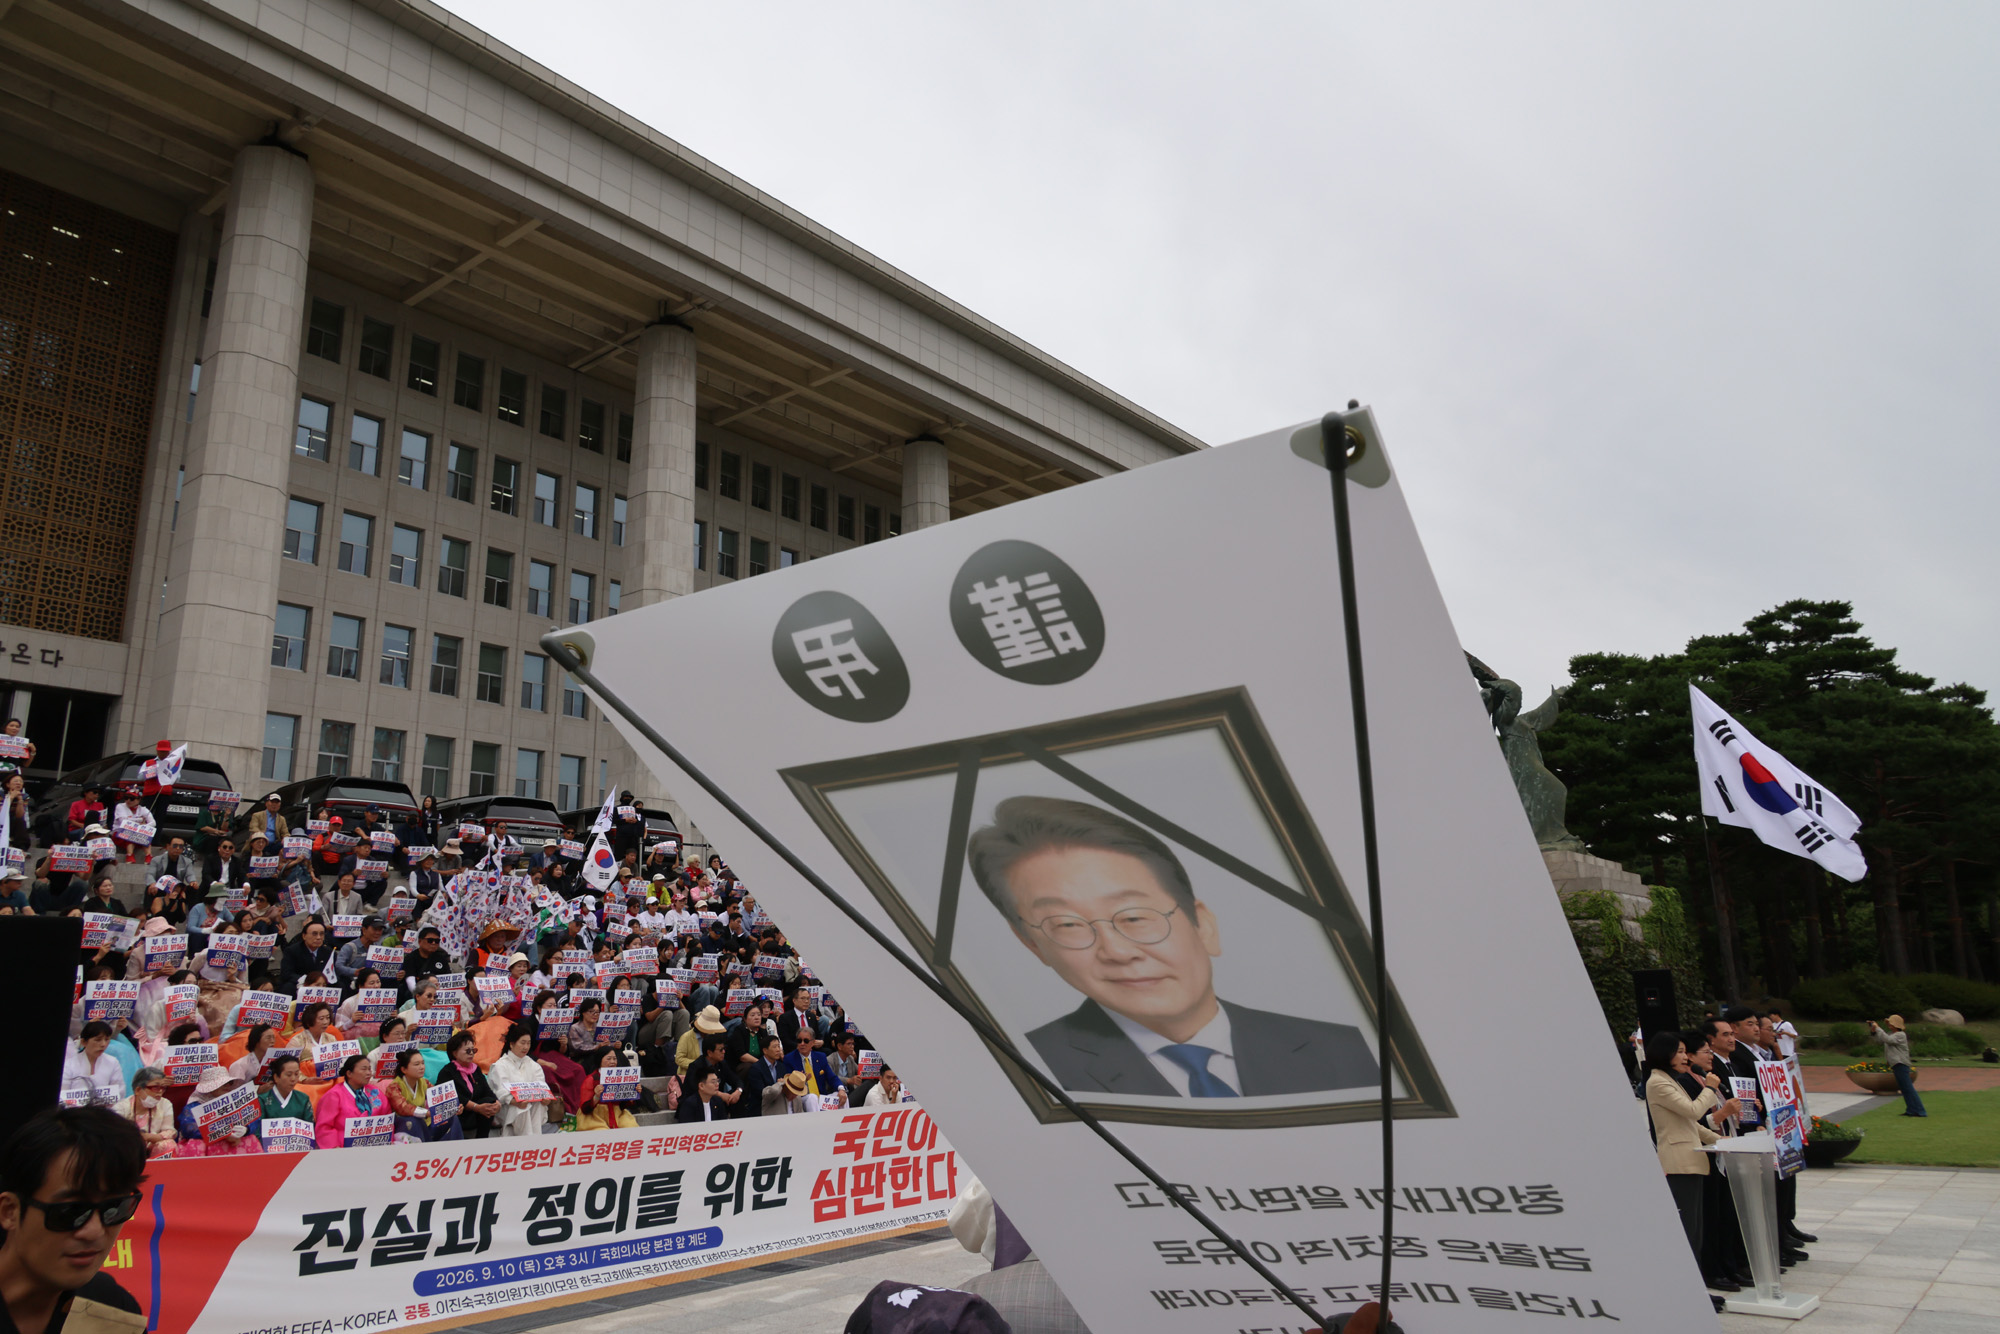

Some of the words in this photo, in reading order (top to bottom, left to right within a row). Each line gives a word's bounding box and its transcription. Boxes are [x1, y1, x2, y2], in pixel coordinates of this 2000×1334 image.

[95, 983, 137, 991] 부정선거
[92, 991, 116, 999] 진실을
[118, 991, 137, 999] 밝혀라
[274, 995, 286, 1003] 말고
[95, 1001, 110, 1009] 518
[112, 1001, 133, 1009] 유공자
[88, 1009, 106, 1018] 전면
[420, 1011, 453, 1019] 부정선거
[175, 1047, 198, 1055] 피하지
[320, 1042, 356, 1053] 부정선거
[167, 1056, 184, 1064] 재판
[185, 1055, 198, 1063] 부터
[200, 1054, 217, 1062] 받아라
[320, 1050, 341, 1060] 진실을
[324, 1062, 337, 1070] 518
[321, 1070, 336, 1078] 전면
[1759, 1064, 1791, 1100] 이재명
[431, 1085, 453, 1096] 부정선거
[606, 1085, 617, 1093] 518
[203, 1097, 229, 1113] 피하지
[231, 1087, 247, 1099] 말고
[602, 1092, 615, 1100] 전면
[199, 1112, 216, 1124] 재판
[217, 1103, 234, 1116] 부터
[235, 1091, 255, 1106] 받아라
[208, 1112, 240, 1132] 국민합의
[270, 1120, 310, 1129] 부정선거
[354, 1117, 394, 1127] 부정선거
[208, 1125, 232, 1142] 개헌은
[268, 1127, 292, 1136] 진실을
[294, 1128, 313, 1138] 밝혀라
[350, 1126, 373, 1136] 진실을
[375, 1124, 393, 1132] 밝혀라
[833, 1108, 938, 1161] 국민이
[272, 1137, 288, 1145] 518
[391, 1148, 557, 1182] 3.5%/175만명의
[559, 1140, 644, 1167] 소금혁명을
[647, 1130, 743, 1156] 국민혁명으로!
[810, 1151, 957, 1223] 심판한다
[292, 1192, 499, 1276] 진실과
[522, 1170, 685, 1246] 정의를
[704, 1156, 793, 1219] 위한
[436, 1269, 478, 1288] 2026.
[482, 1267, 495, 1280] 9.
[499, 1263, 515, 1277] 10
[519, 1259, 540, 1275] (목)
[544, 1255, 566, 1271] 오후
[570, 1251, 588, 1266] 3시
[600, 1241, 650, 1261] 국회의사당
[653, 1238, 673, 1253] 본관
[676, 1236, 685, 1249] 앞
[688, 1232, 707, 1246] 계단
